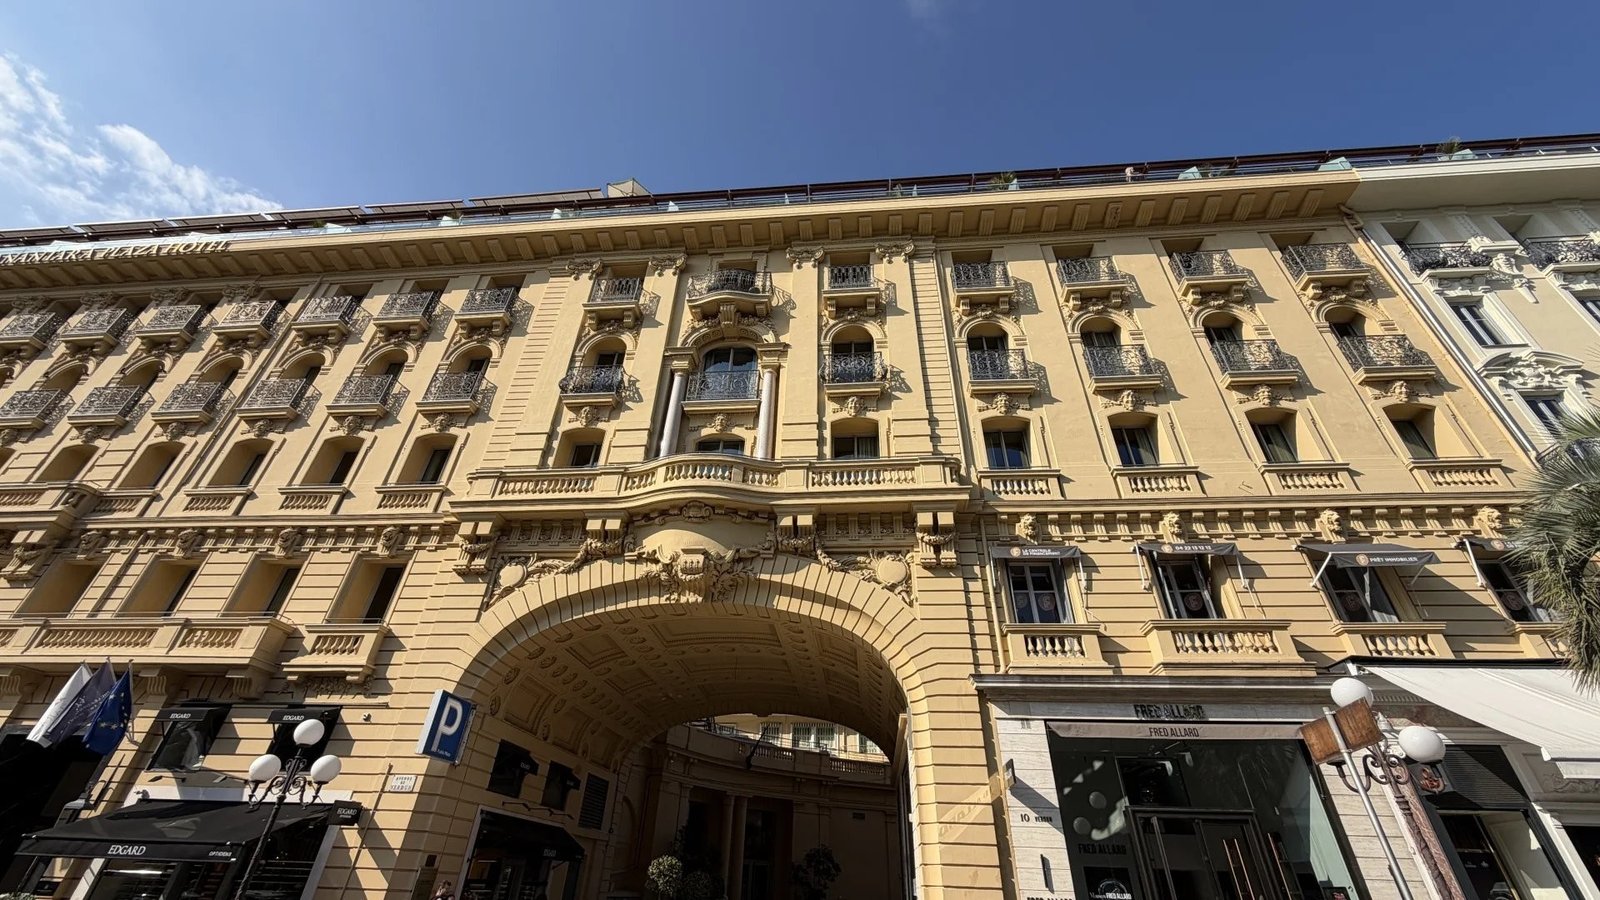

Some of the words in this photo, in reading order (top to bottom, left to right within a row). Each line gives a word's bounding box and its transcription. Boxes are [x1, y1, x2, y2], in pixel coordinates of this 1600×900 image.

[0, 249, 94, 265] NANTARA
[103, 244, 159, 257] PLAZA
[166, 240, 229, 254] HOTEL
[431, 697, 463, 752] P
[1149, 727, 1169, 737] FRED
[1170, 728, 1199, 737] ALLARD
[1020, 813, 1030, 822] 10
[107, 845, 147, 856] EDGARD
